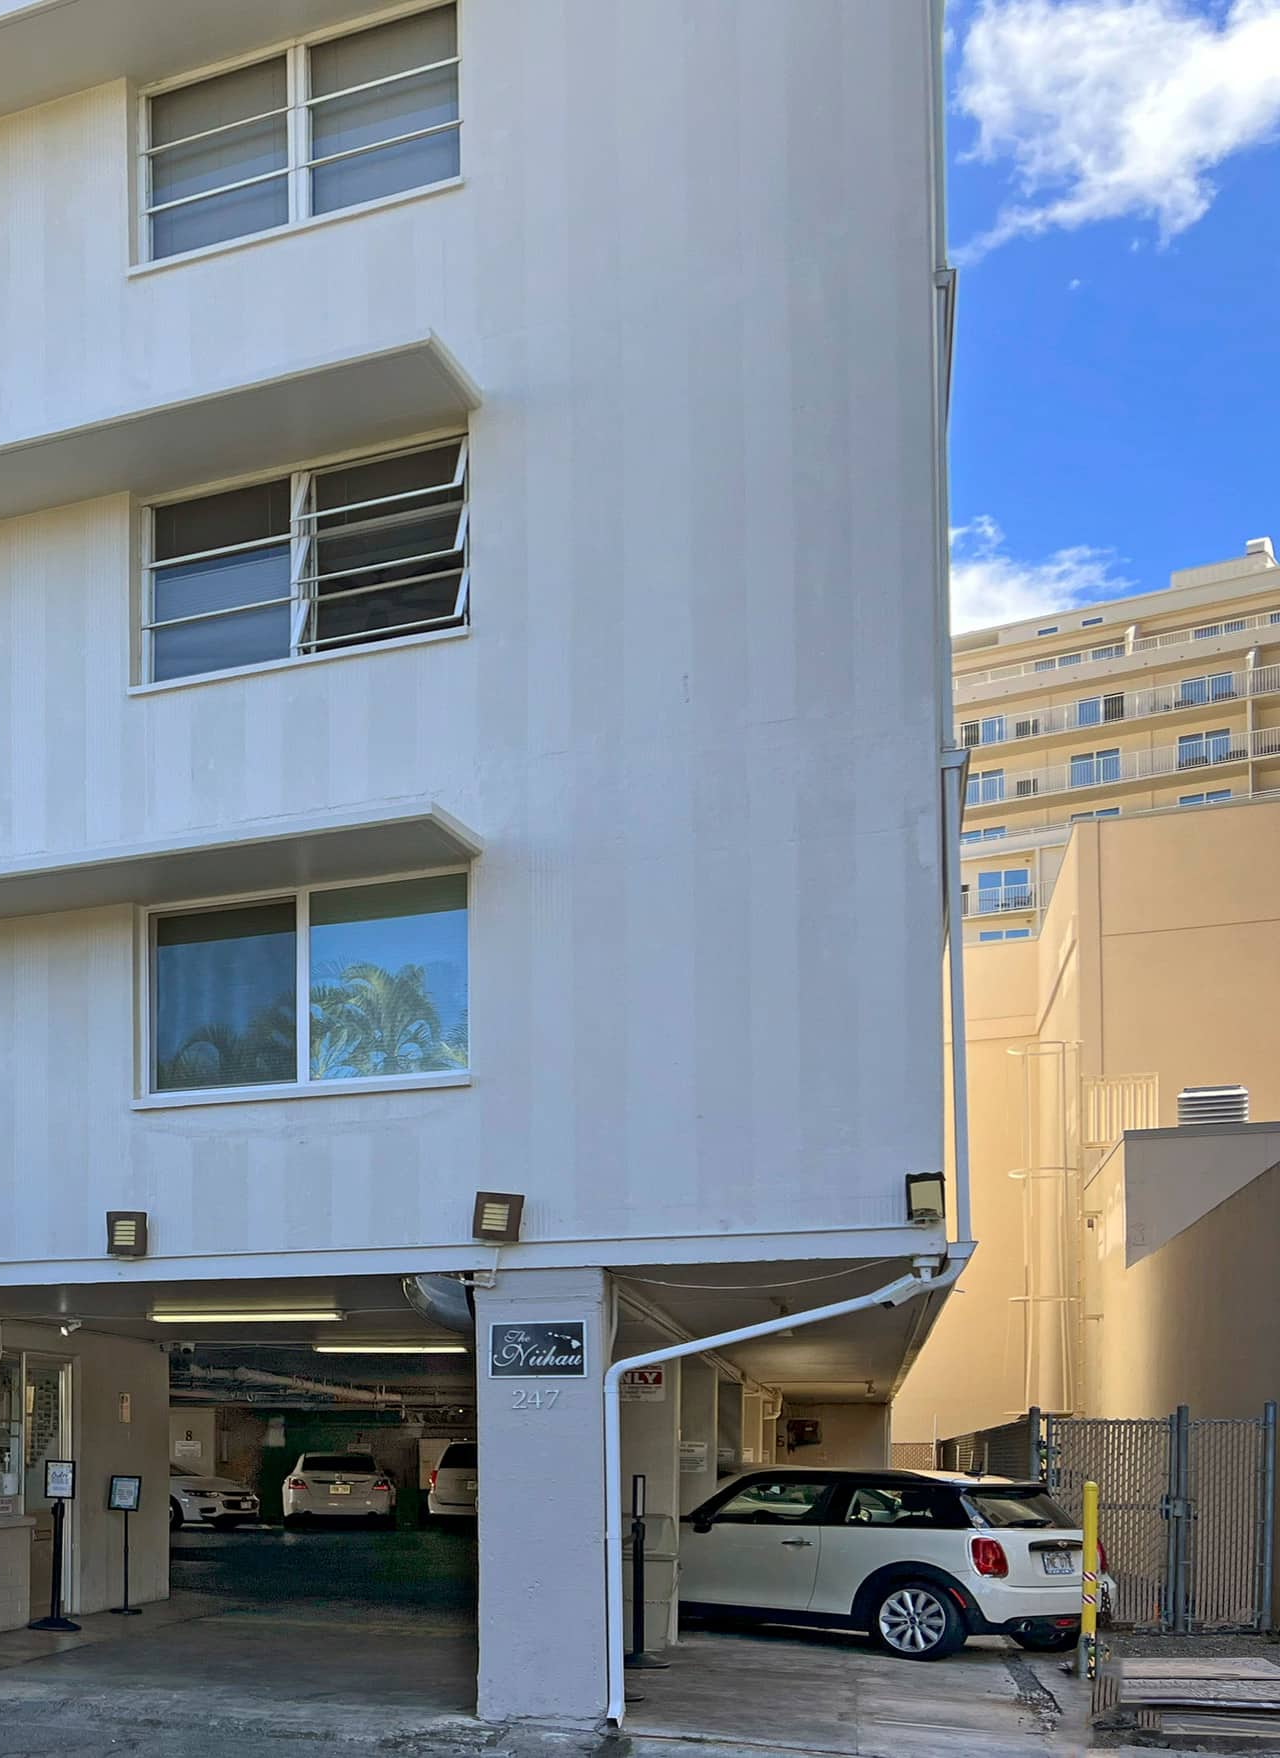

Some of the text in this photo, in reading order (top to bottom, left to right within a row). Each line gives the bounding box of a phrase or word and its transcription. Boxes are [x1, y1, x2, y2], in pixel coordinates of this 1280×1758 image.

[503, 1329, 532, 1343] The
[623, 1371, 659, 1384] NLY
[511, 1388, 561, 1409] 247
[185, 1430, 193, 1441] 8
